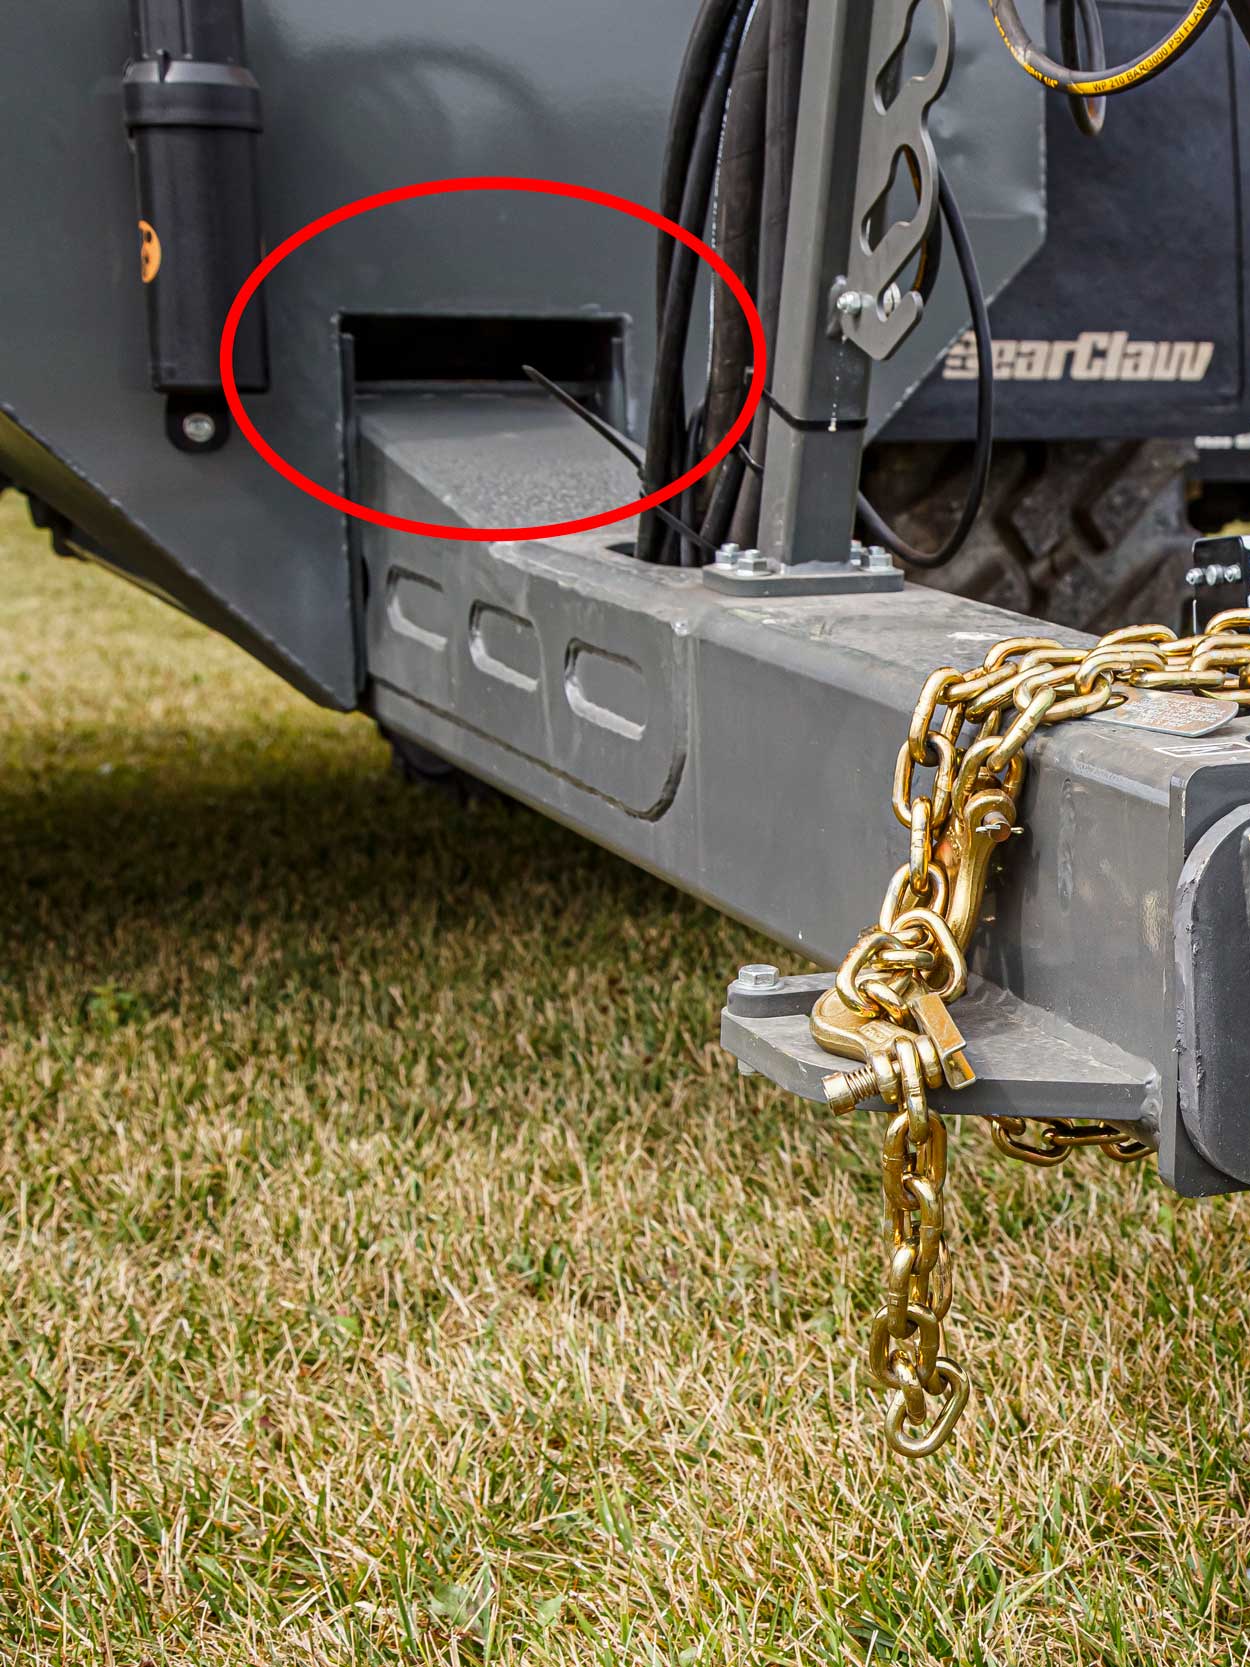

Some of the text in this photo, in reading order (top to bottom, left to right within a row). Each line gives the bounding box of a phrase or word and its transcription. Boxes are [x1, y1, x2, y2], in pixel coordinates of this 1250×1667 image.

[1093, 82, 1107, 92] WP
[1110, 77, 1126, 88] 210
[1168, 30, 1185, 49] PSI
